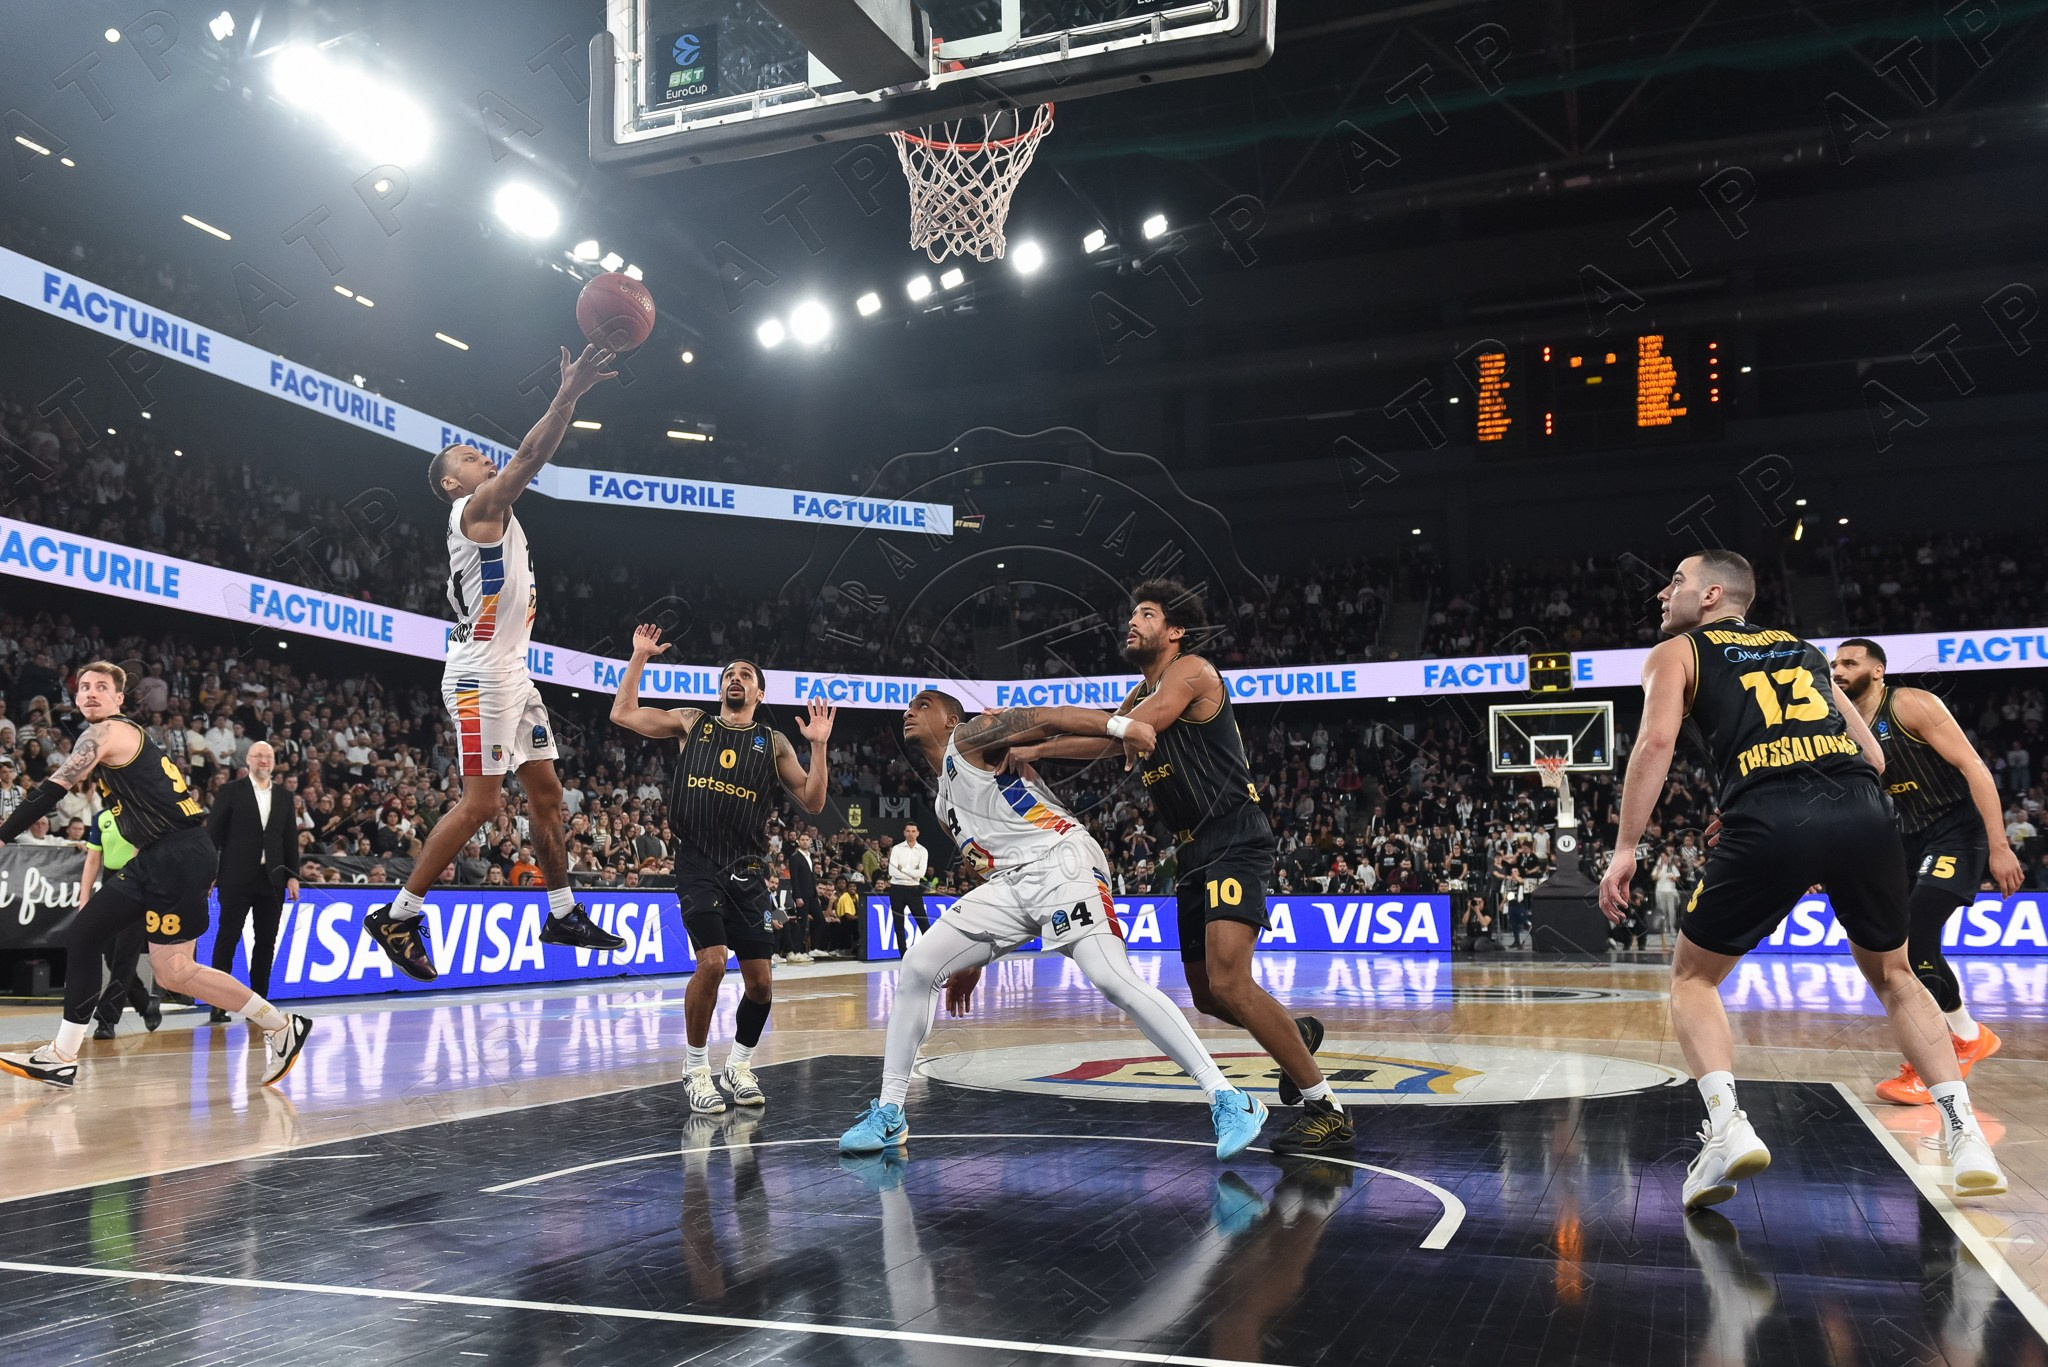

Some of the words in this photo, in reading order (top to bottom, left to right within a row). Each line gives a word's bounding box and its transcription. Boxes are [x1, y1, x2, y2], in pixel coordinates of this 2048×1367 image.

[666, 84, 708, 100] EuroCup
[667, 67, 705, 88] BKT
[43, 271, 210, 363] FACTURILE
[271, 361, 396, 431] FACTURILE
[589, 474, 736, 510] FACTURILE
[792, 494, 926, 528] FACTURILE
[0, 531, 180, 600] ACTURILE
[249, 583, 394, 643] FACTURILE
[1223, 670, 1357, 698] ACTURILE
[1739, 665, 1830, 729] 13
[719, 748, 737, 769] 0
[687, 774, 757, 802] betsson
[947, 807, 962, 837] 4
[1931, 855, 1958, 880] 5
[1206, 877, 1242, 909] 10
[145, 910, 182, 936] 98
[1070, 901, 1094, 927] 4
[1311, 901, 1440, 945] VISA
[1942, 899, 2048, 947] ISA
[427, 902, 545, 975] VISA
